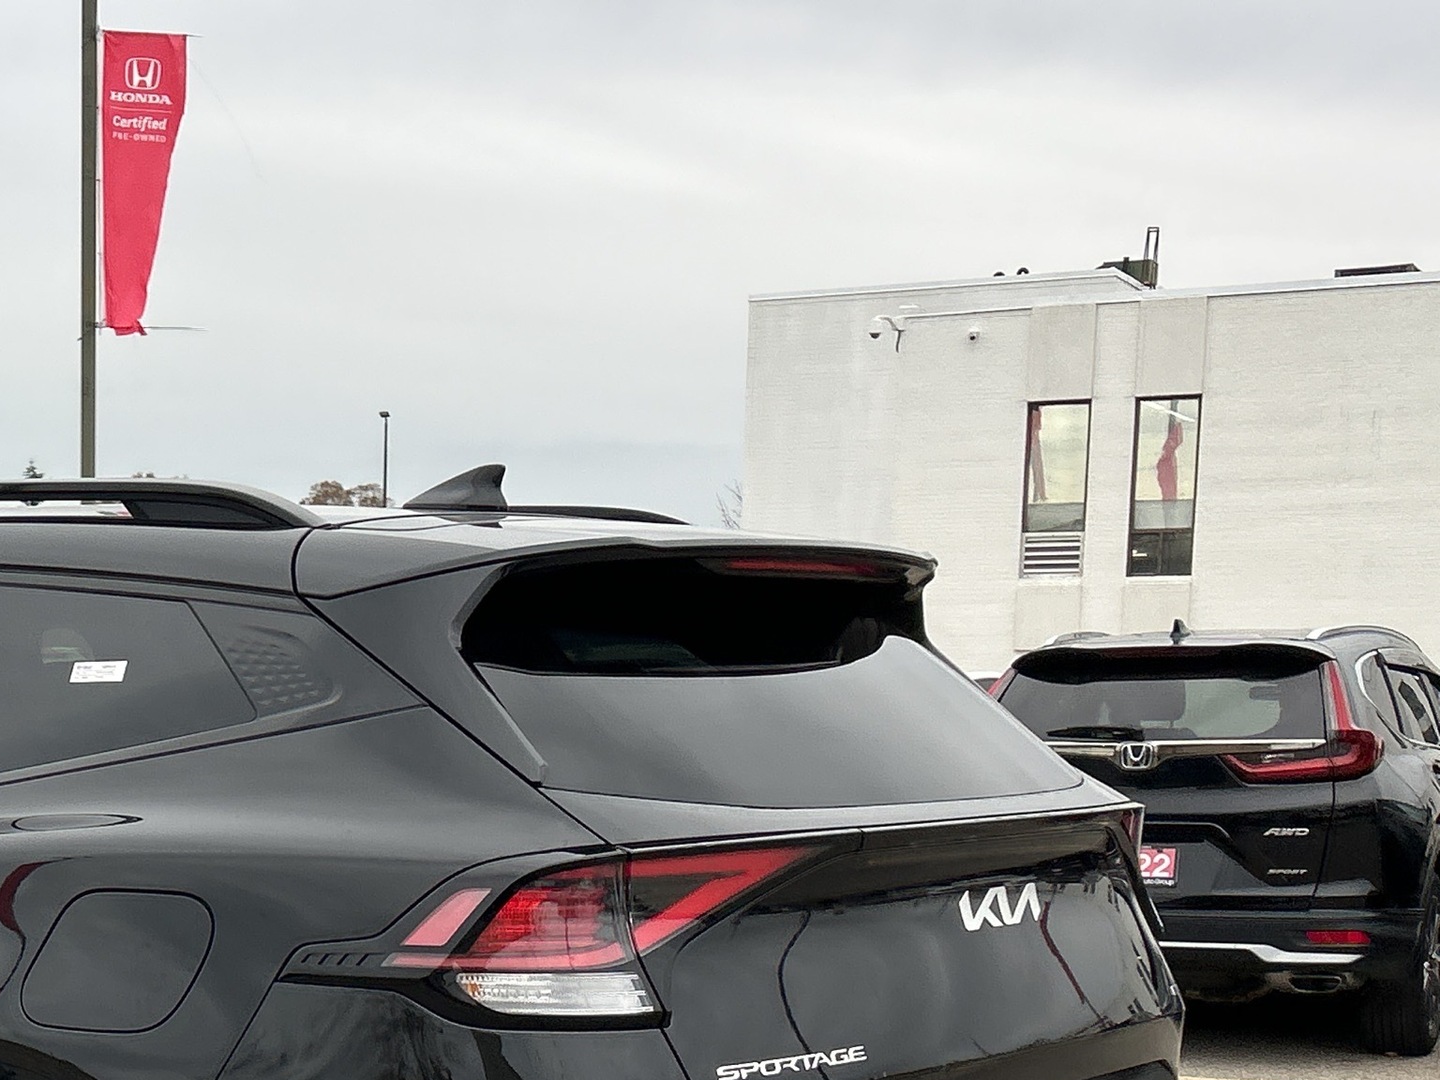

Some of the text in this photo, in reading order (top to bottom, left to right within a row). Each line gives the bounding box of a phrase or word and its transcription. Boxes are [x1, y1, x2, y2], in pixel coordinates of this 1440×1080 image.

[109, 91, 173, 105] HONDA
[112, 115, 168, 132] Certified
[1263, 827, 1310, 836] AWD
